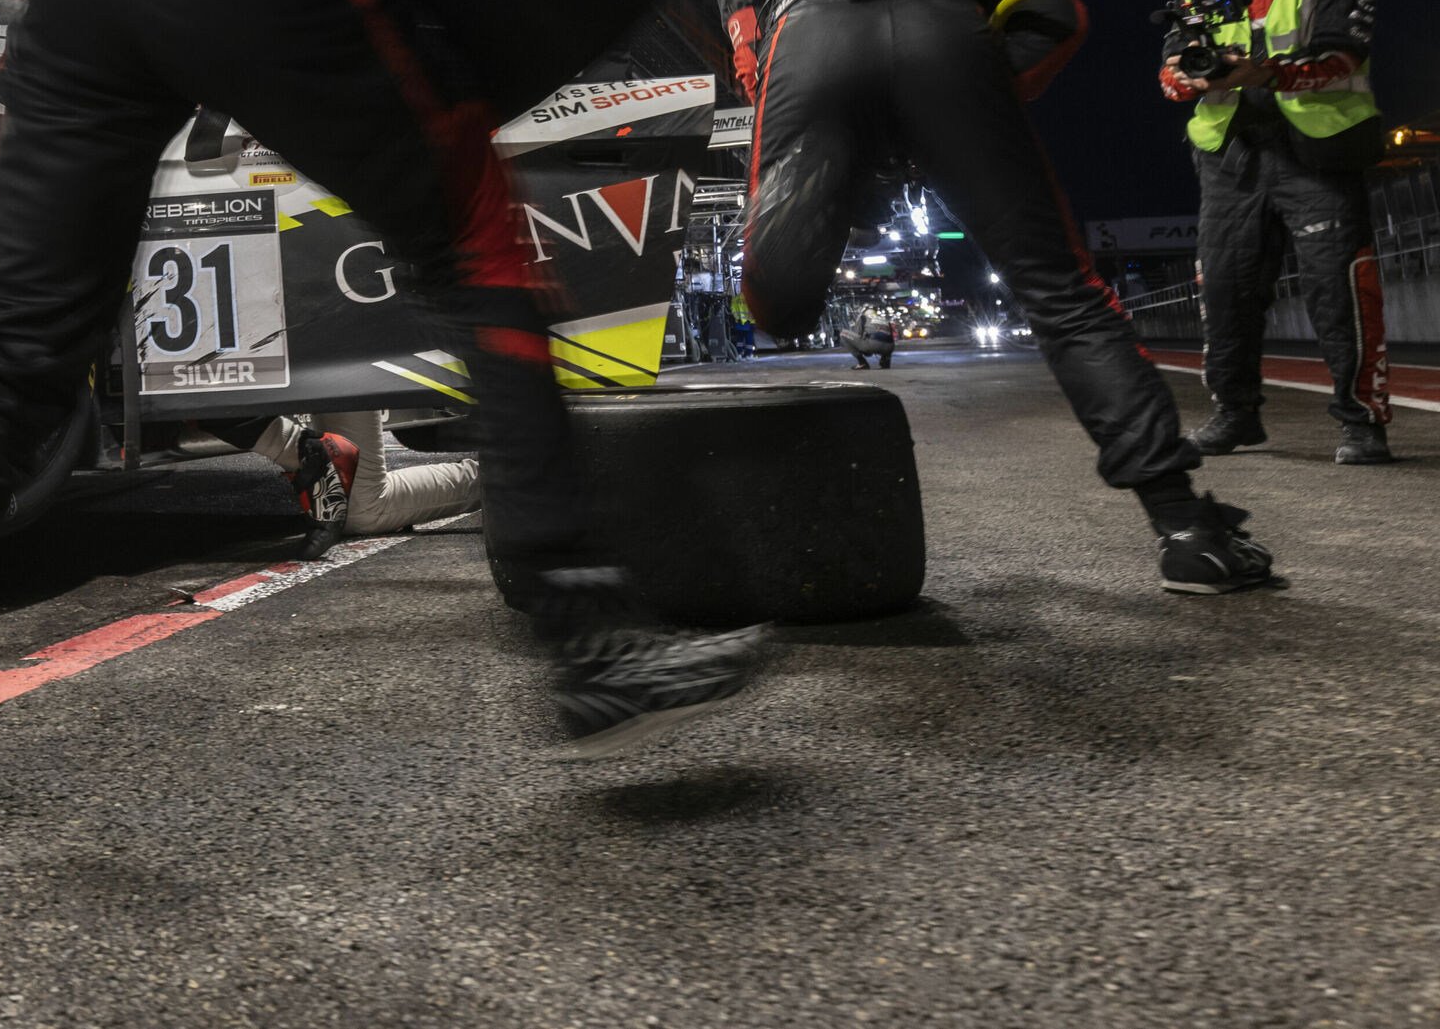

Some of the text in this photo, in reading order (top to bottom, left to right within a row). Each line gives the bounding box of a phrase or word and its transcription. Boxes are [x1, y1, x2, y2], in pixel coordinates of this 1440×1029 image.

[530, 78, 711, 124] SIM SPORTS
[253, 174, 292, 184] PIRELLI
[145, 240, 239, 356] 31
